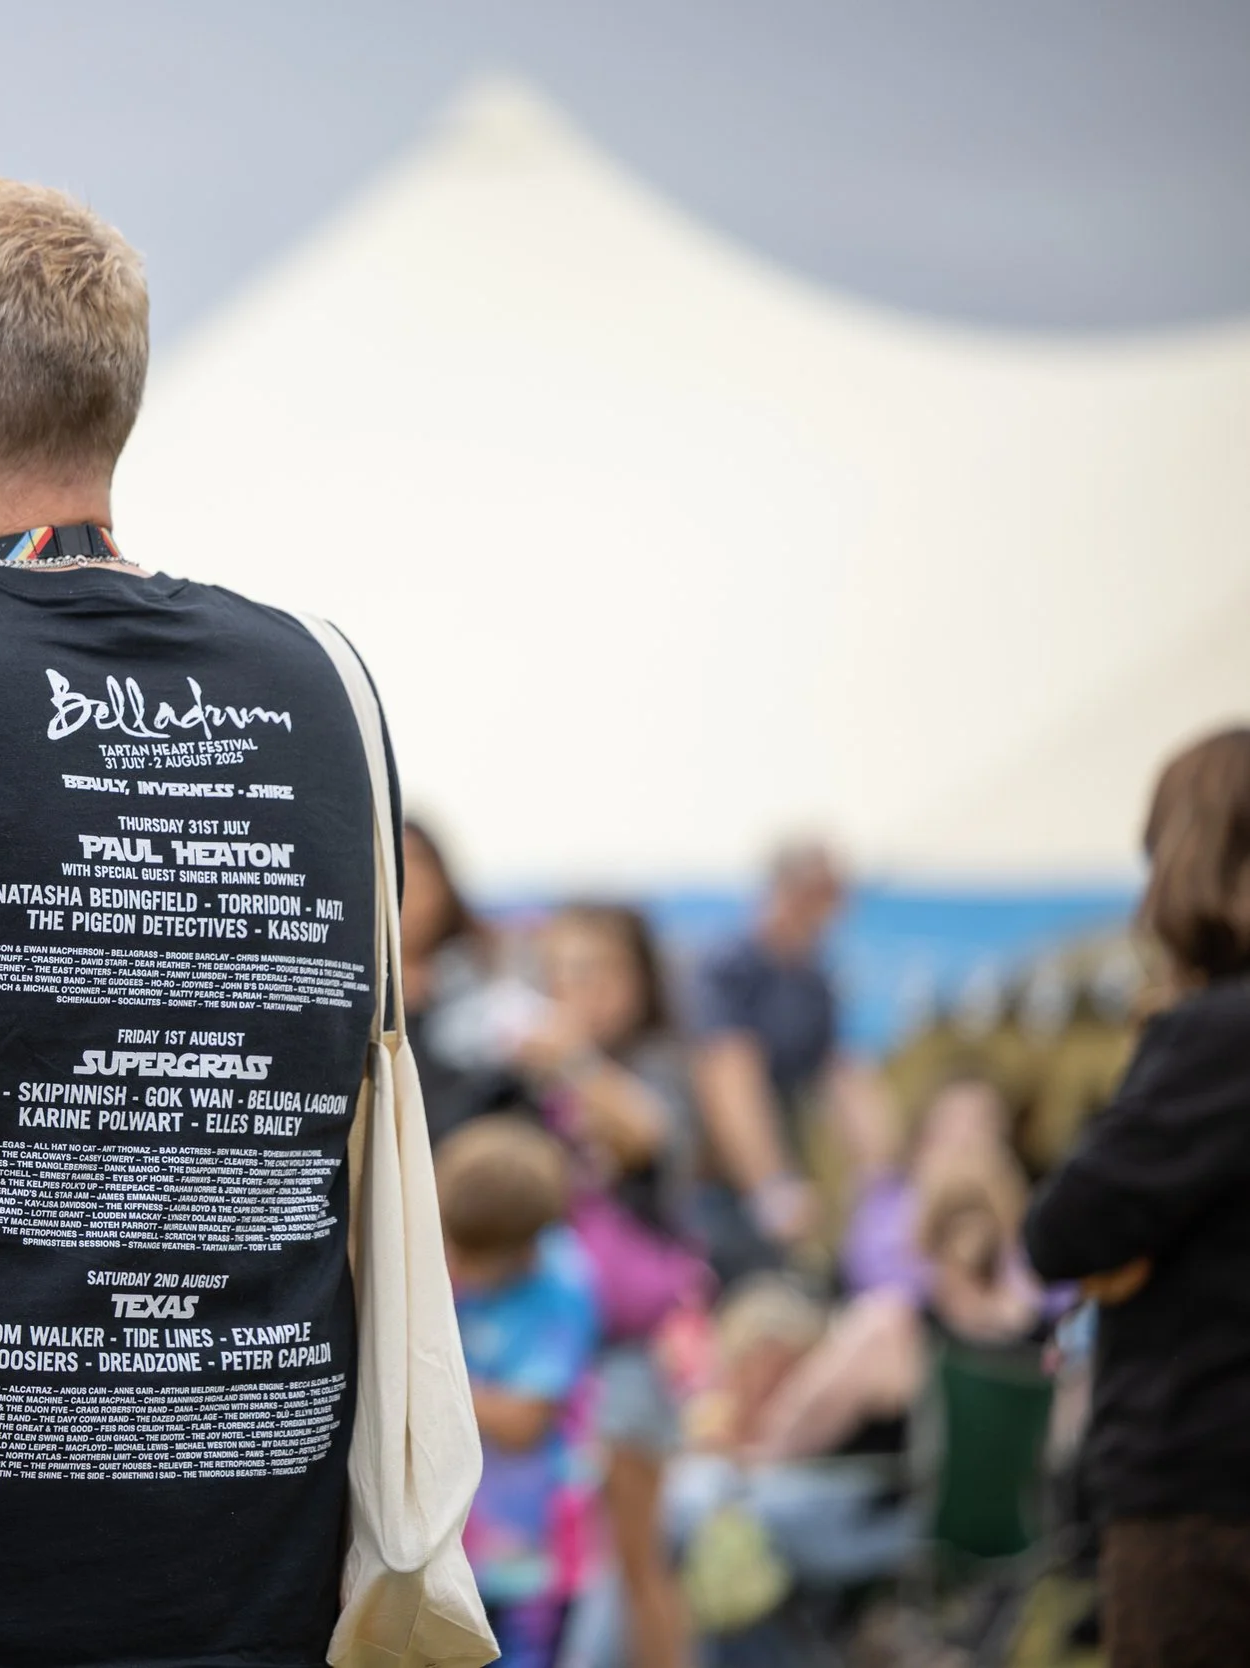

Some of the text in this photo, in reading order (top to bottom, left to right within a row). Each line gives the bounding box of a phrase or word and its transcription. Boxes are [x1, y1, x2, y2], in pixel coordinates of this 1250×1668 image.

[46, 668, 292, 740] Belladrum
[98, 738, 258, 757] TARTAN HEART FESTIVAL
[105, 752, 244, 769] 31 JULY 2 AUGUST 2025
[62, 774, 294, 800] BEAULY, INVERNESS SHIRE
[118, 816, 251, 835] THURSDAY 31ST JULY
[78, 834, 294, 868] PAUL HEATON
[62, 863, 306, 887] WITH SPECIAL GUEST SINGER RIANNE DOWNEY
[89, 887, 197, 912] BEDINGFIELD
[218, 894, 301, 916] TORRIDON
[316, 898, 344, 921] NATI.
[27, 909, 329, 944] THE PIGEON DETECTIVES KASSIDY
[50, 947, 104, 956] MACPHERSON
[31, 955, 73, 964] CRASHKID
[118, 969, 159, 977] FALASGAIR
[10, 974, 33, 982] GLEN
[35, 975, 61, 984] SWING
[151, 980, 175, 988] HO-RO
[56, 996, 255, 1009] SCHIEHALLION SOCIALITES SUN DAY
[232, 992, 262, 1000] PARIAH
[117, 1029, 245, 1047] FRIDAY 1ST AUGUST
[73, 1050, 273, 1080] SUPERGRASS
[18, 1082, 127, 1105] SKIPINNISH
[145, 1086, 183, 1108] GOK
[189, 1088, 234, 1109] WAN
[247, 1090, 301, 1112] BELUGA
[304, 1093, 348, 1115] LAGOON
[18, 1106, 302, 1136] KARINE POLWART ELLES BAILEY
[118, 1146, 150, 1154] THOMAZ
[104, 1164, 126, 1172] DANK
[128, 1165, 160, 1173] MANGO
[224, 1158, 258, 1166] CLEAVERS
[113, 1174, 135, 1182] EYES
[105, 1184, 155, 1192] FREEPEACE
[96, 1192, 124, 1200] JAMES
[127, 1193, 171, 1202] EMMANUEL
[124, 1203, 163, 1211] KIFFNESS
[128, 1212, 162, 1221] MACKAY
[192, 1214, 216, 1222] DOLAN
[90, 1221, 120, 1229] MOTEH
[122, 1222, 158, 1230] PARROTT
[85, 1230, 117, 1238] RHUARI
[120, 1231, 158, 1239] CAMPBELL
[79, 1240, 120, 1248] SESSIONS
[162, 1242, 195, 1251] WEATHER
[248, 1243, 267, 1251] TOBY
[87, 1270, 230, 1289] SATURDAY 2ND AUGUST
[111, 1294, 199, 1319] TEXAS
[30, 1325, 104, 1347] WALKER
[123, 1328, 159, 1348] TIDE
[165, 1328, 214, 1348] LINES
[231, 1321, 311, 1347] EXAMPLE
[99, 1352, 202, 1373] DREADZONE
[221, 1349, 274, 1371] PETER
[278, 1342, 331, 1368] CAPALDI
[60, 1387, 87, 1395] ANGUS
[88, 1387, 106, 1395] CAIN
[218, 1421, 255, 1429] FLORENCE
[65, 1444, 107, 1452] MACFLOYD
